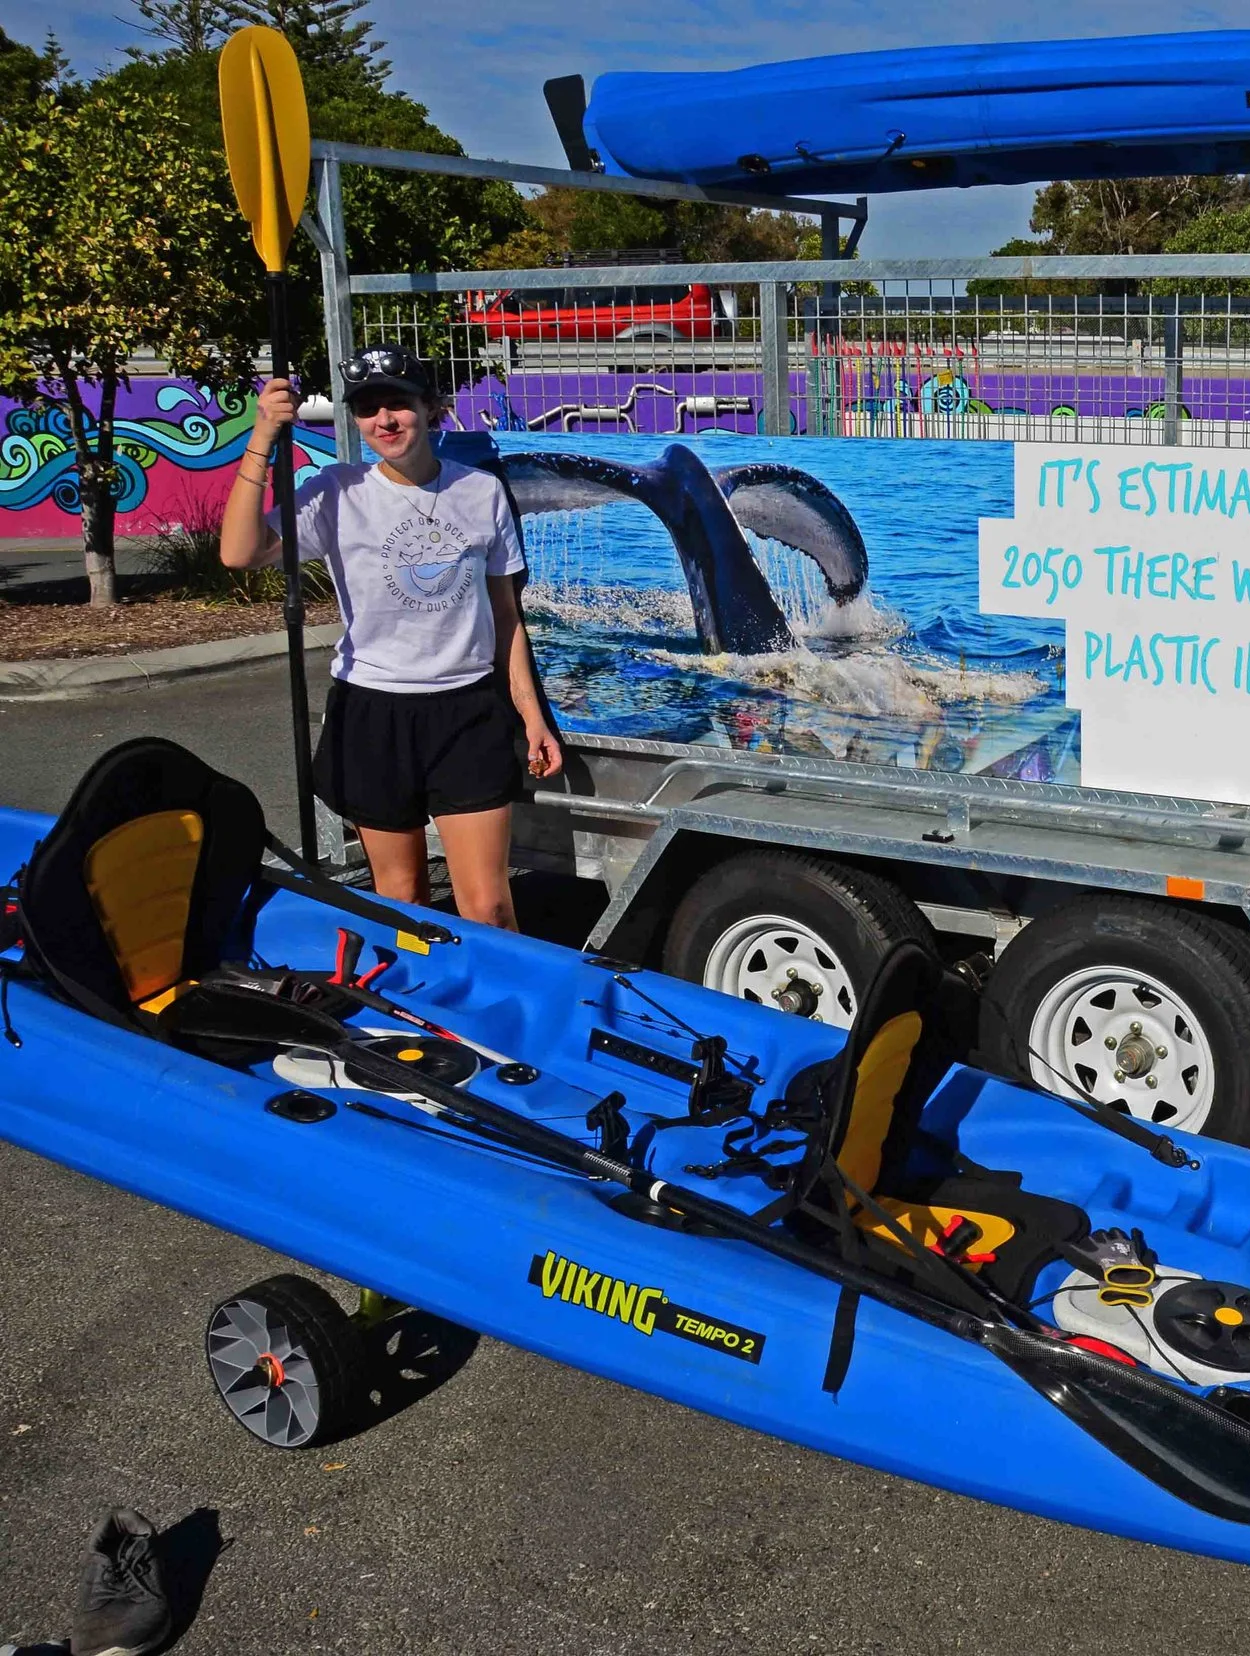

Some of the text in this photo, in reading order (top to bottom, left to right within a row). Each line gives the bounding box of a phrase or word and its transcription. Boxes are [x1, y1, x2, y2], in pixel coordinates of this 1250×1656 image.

[1038, 457, 1102, 514] IT'S
[381, 519, 414, 559] PROTECT
[384, 567, 474, 613] PROTECT OUR FUTURE
[1001, 545, 1084, 605] 2050
[1094, 546, 1217, 601] THERE
[1084, 630, 1221, 695] PLASTIC
[541, 1250, 756, 1355] VIKING TEMPO 2
